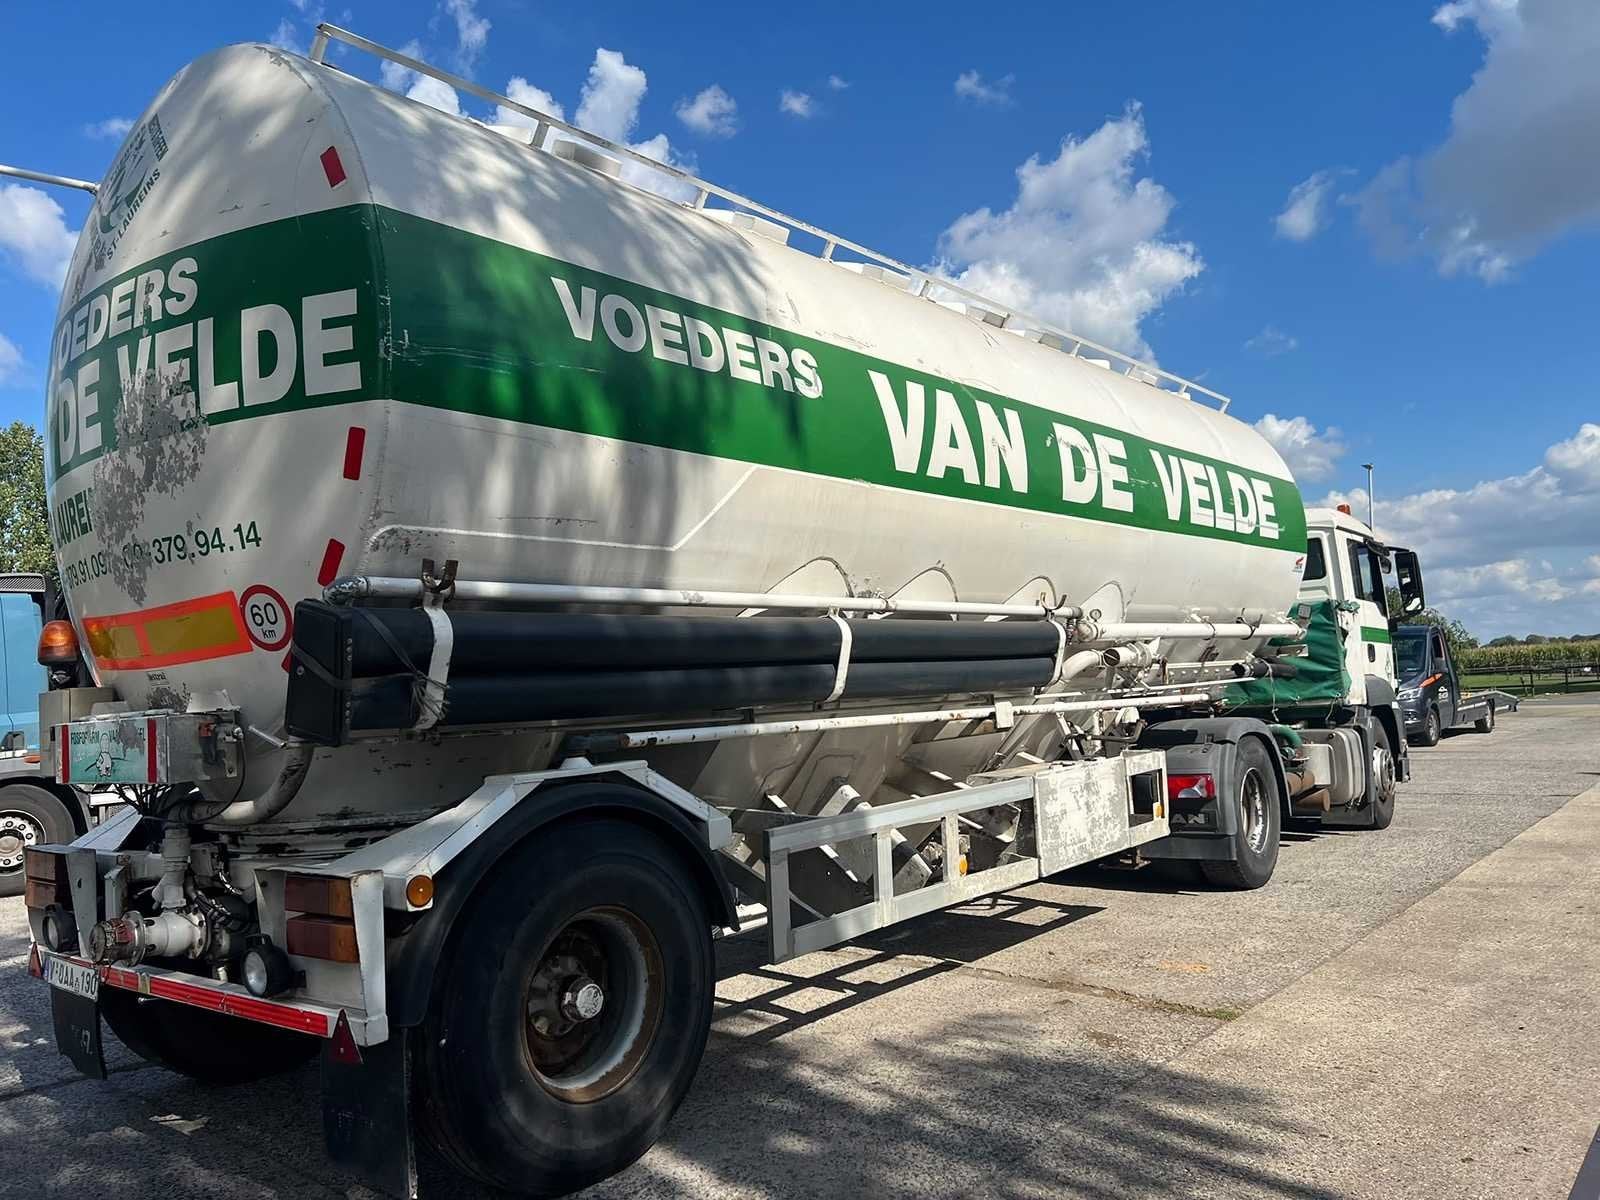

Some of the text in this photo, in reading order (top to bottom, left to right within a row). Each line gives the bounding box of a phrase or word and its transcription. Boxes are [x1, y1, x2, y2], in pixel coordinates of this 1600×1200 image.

[105, 168, 161, 260] ST-LAUREINS
[58, 288, 362, 466] DE VELDE
[551, 276, 823, 399] VOEDERS
[867, 369, 1280, 540] VAN DE VELDE
[250, 602, 278, 627] 60
[261, 628, 277, 639] km
[1171, 813, 1205, 824] AN
